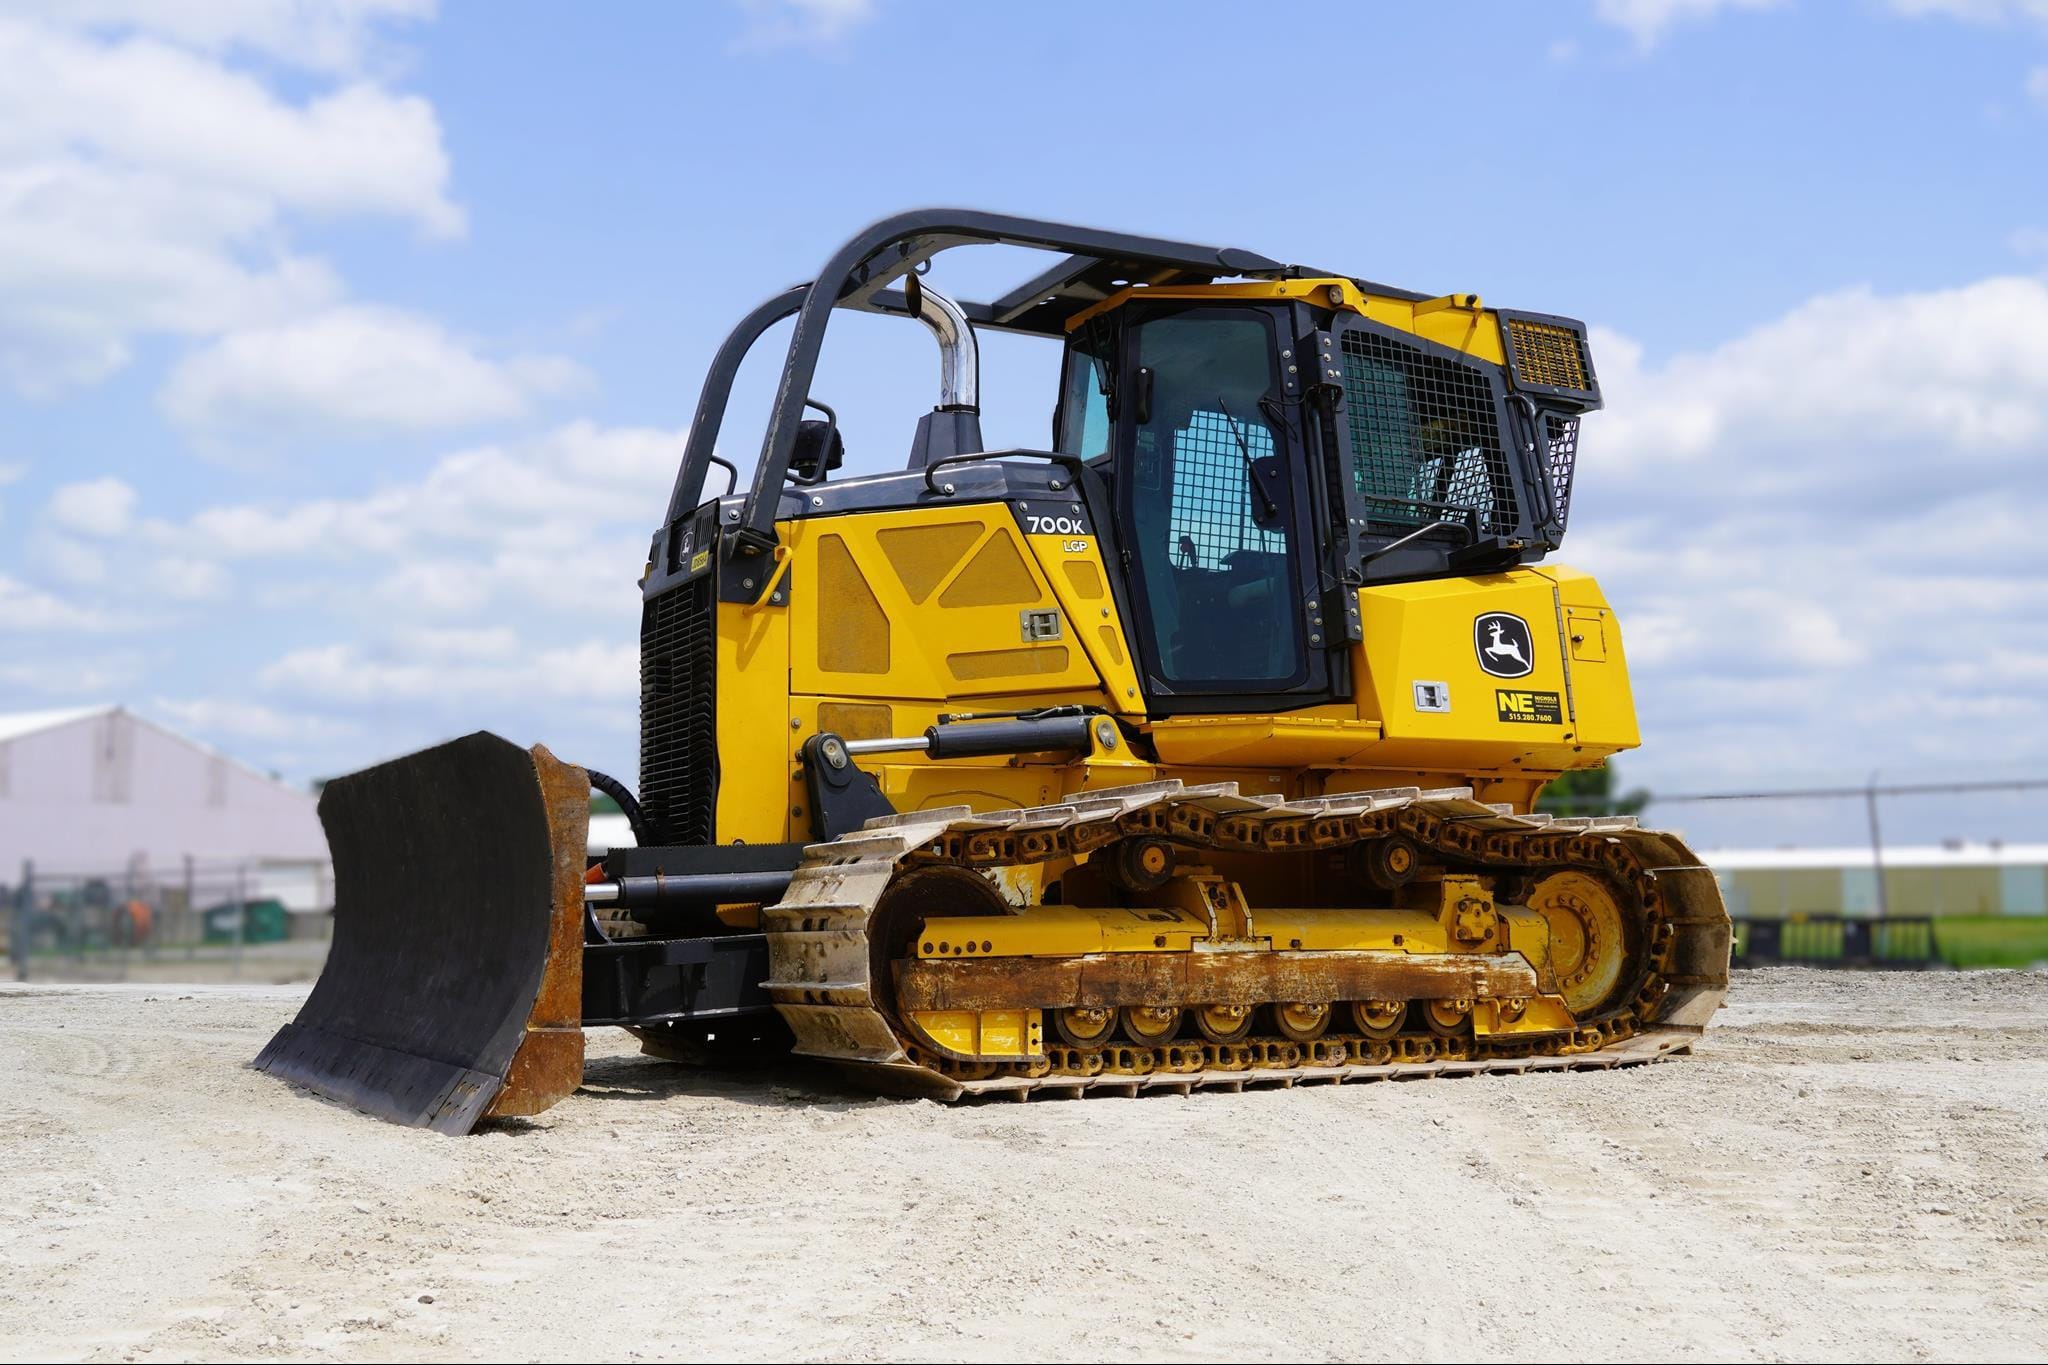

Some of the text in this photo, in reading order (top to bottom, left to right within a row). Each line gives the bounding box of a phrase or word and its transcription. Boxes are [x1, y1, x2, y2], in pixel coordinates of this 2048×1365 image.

[1027, 516, 1085, 534] 700K
[1063, 541, 1087, 552] LGP
[1498, 692, 1534, 712] NE
[1509, 713, 1552, 722] 515.280.7600
